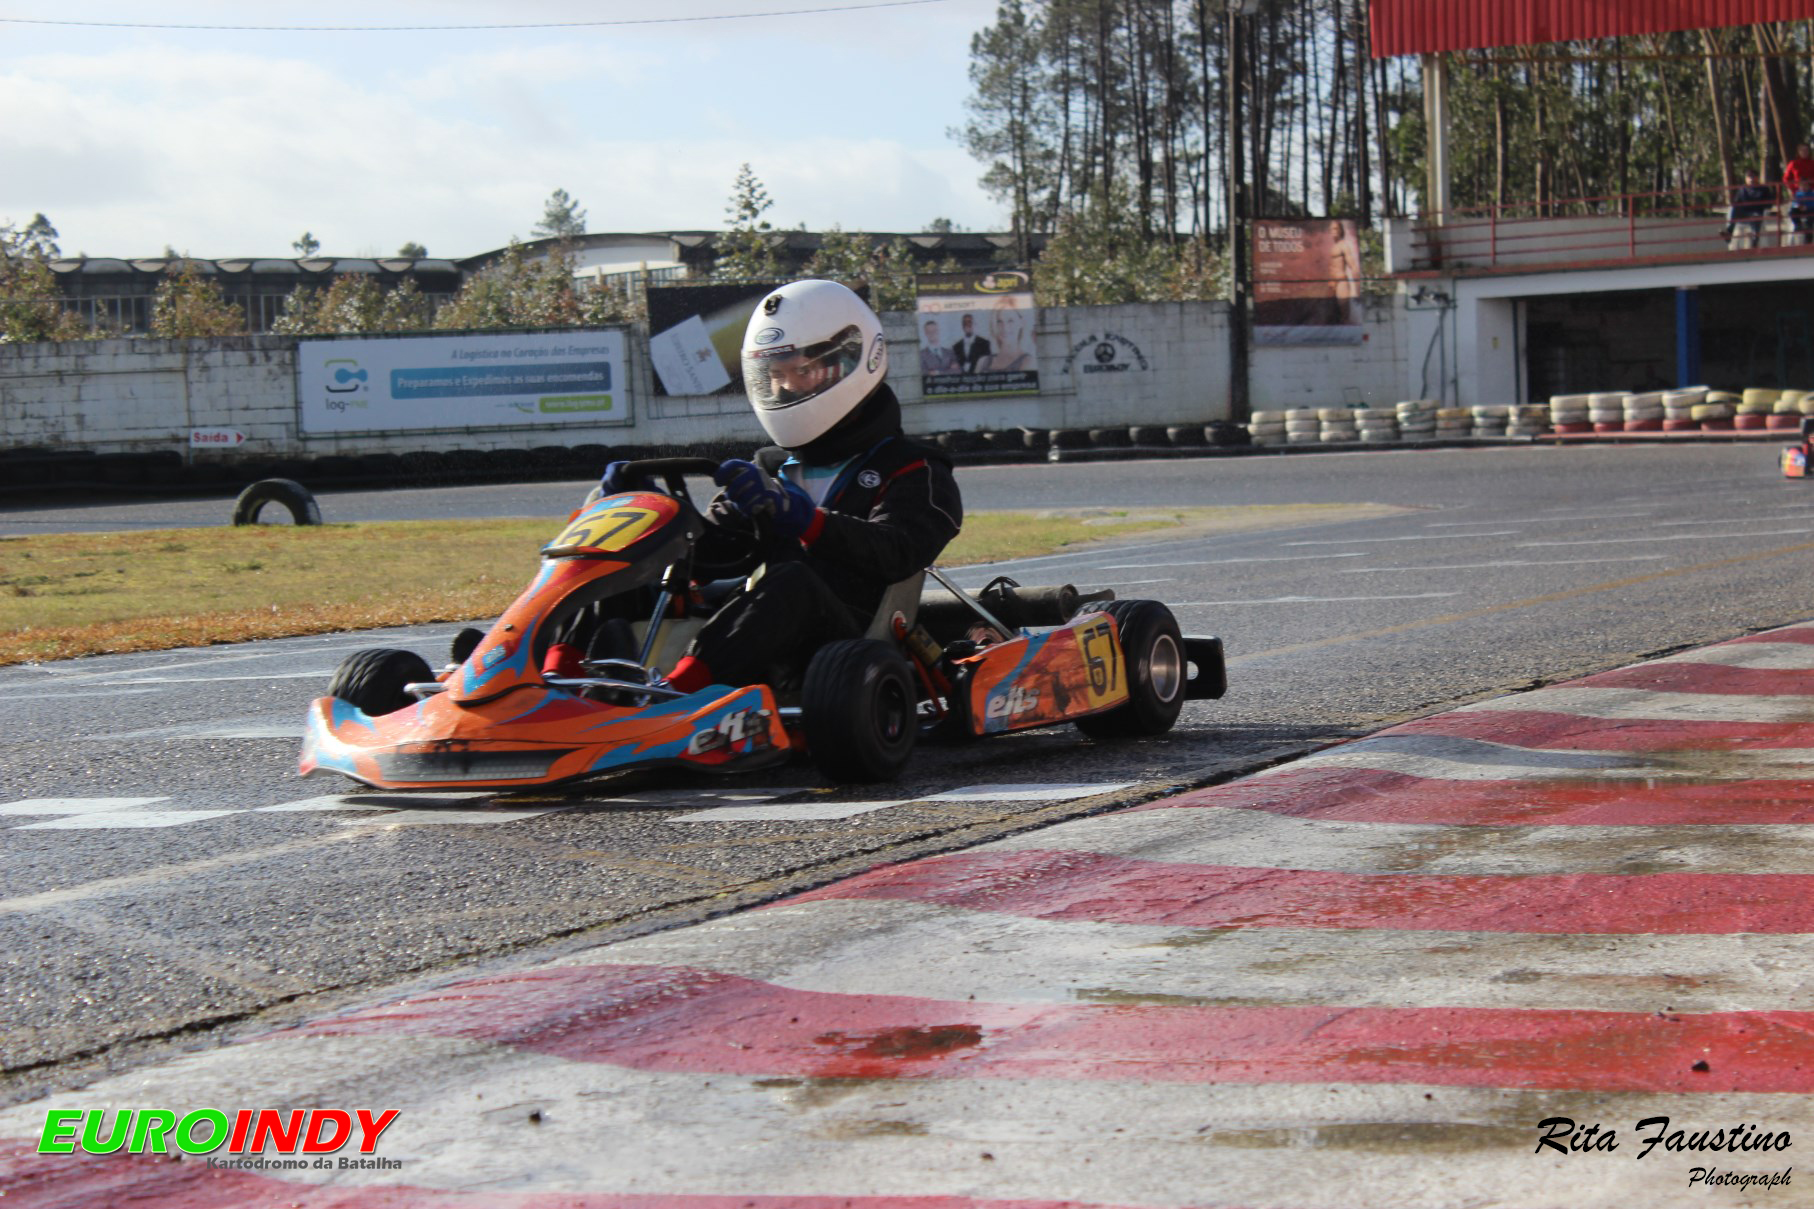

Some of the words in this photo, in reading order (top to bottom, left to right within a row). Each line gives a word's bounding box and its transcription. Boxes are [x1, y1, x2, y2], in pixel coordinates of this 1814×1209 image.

[1268, 226, 1303, 239] MUSEU
[1258, 240, 1273, 253] DE
[1273, 240, 1305, 253] TODOS
[397, 377, 454, 390] Preparamos
[455, 379, 461, 387] e
[462, 374, 512, 388] Expedimos
[513, 375, 524, 385] as
[525, 375, 545, 384] suas
[546, 370, 604, 383] encomendas
[1082, 621, 1117, 697] 67
